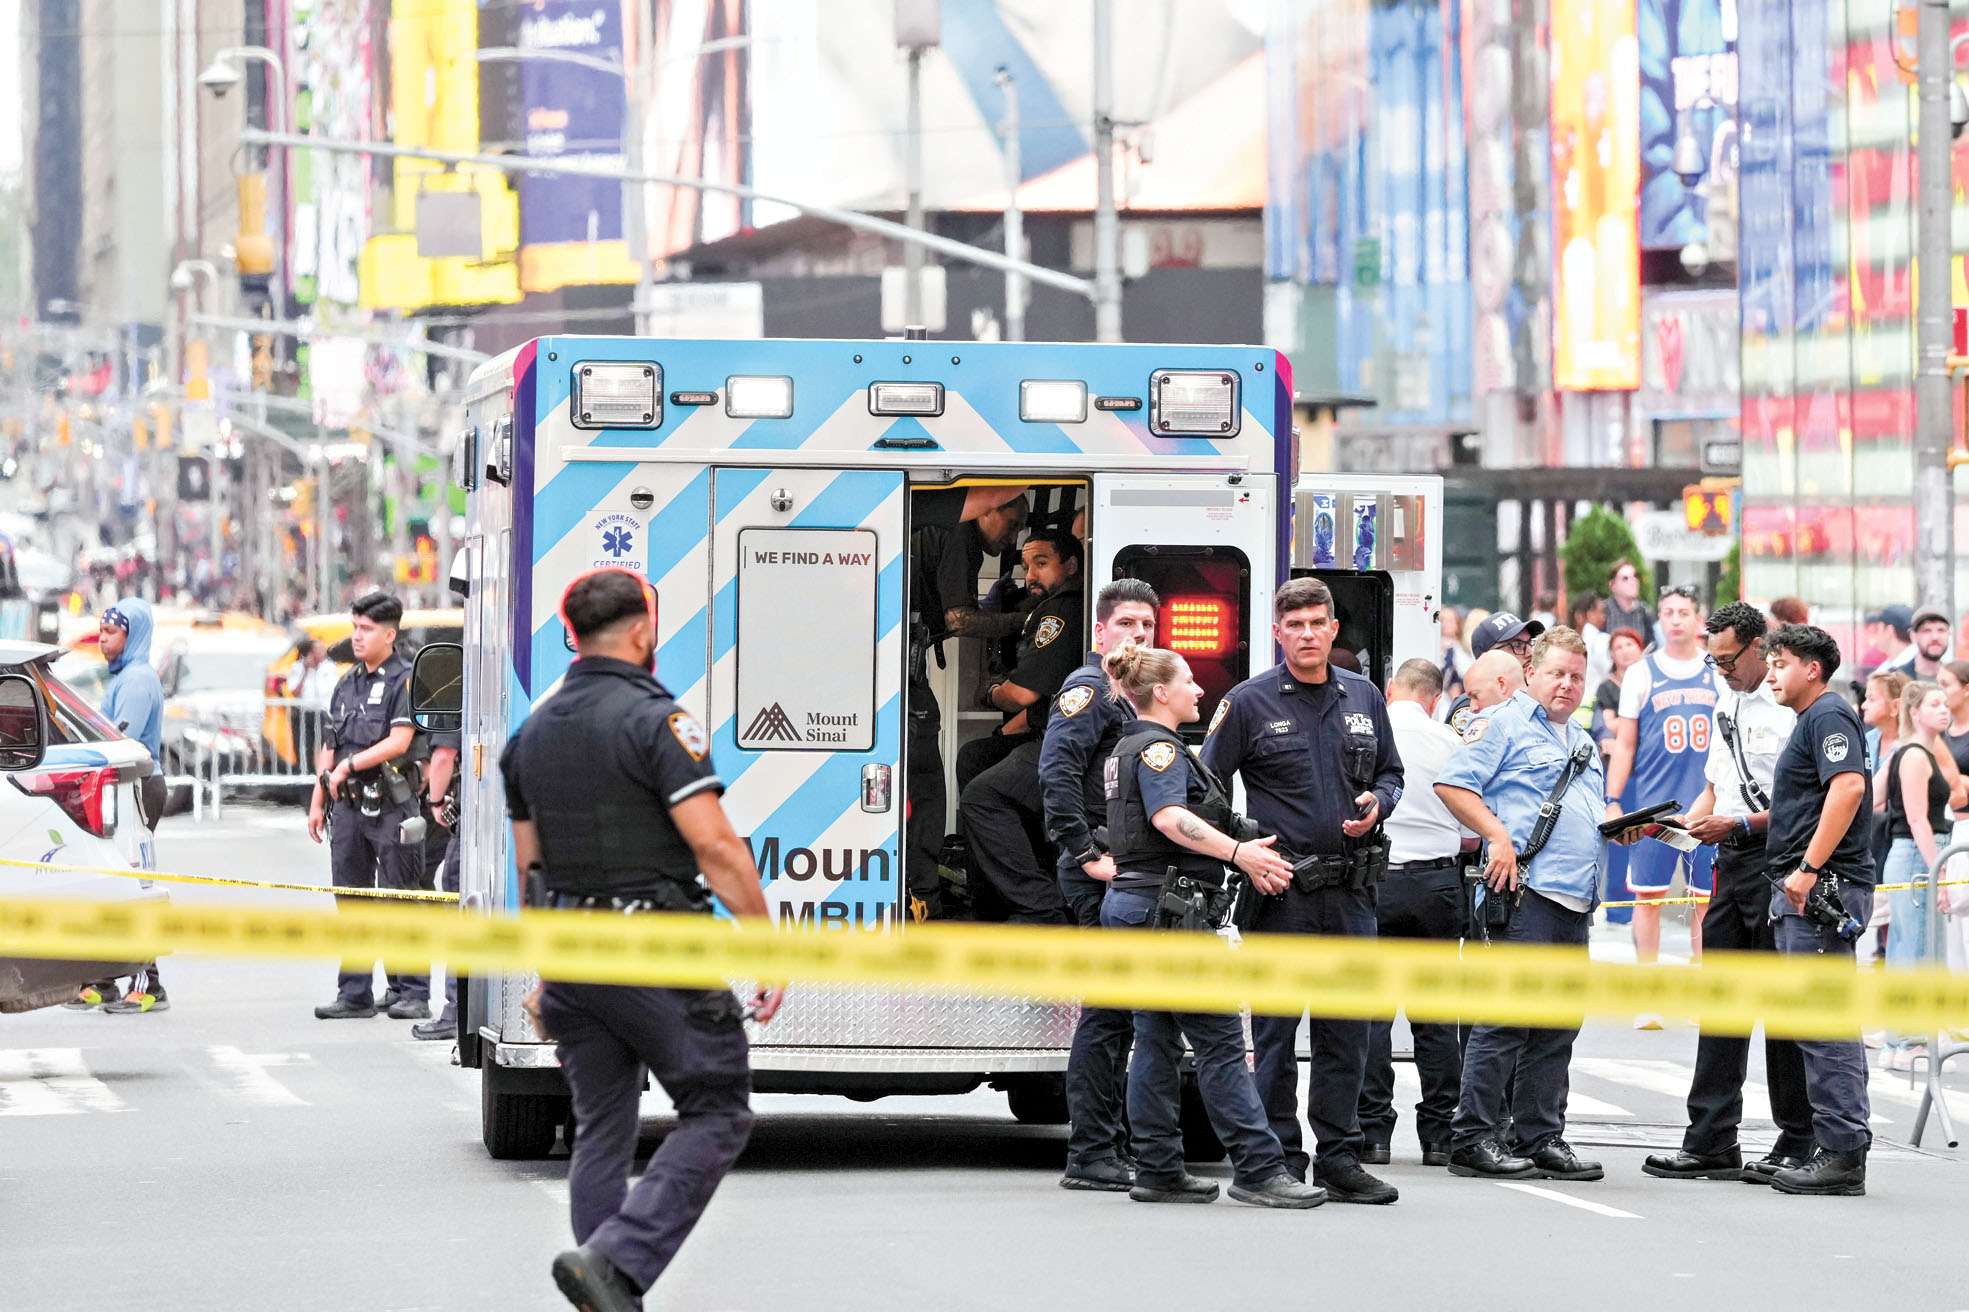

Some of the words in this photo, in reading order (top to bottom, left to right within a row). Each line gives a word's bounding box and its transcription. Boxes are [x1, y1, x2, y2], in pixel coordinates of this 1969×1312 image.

[595, 518, 607, 530] NEW
[625, 517, 640, 530] STATE
[593, 560, 641, 569] CERTIFIED
[755, 551, 777, 564] WE
[782, 552, 819, 565] FIND
[823, 553, 834, 565] A
[838, 553, 871, 566] WAY
[1651, 689, 1682, 713] NEW
[1680, 687, 1717, 708] YORK
[806, 712, 858, 726] Mount
[1269, 719, 1291, 729] LONGA
[1344, 715, 1374, 729] POLICE
[806, 728, 847, 742] Sinai
[1663, 714, 1711, 754] 88
[740, 836, 897, 882] Moun
